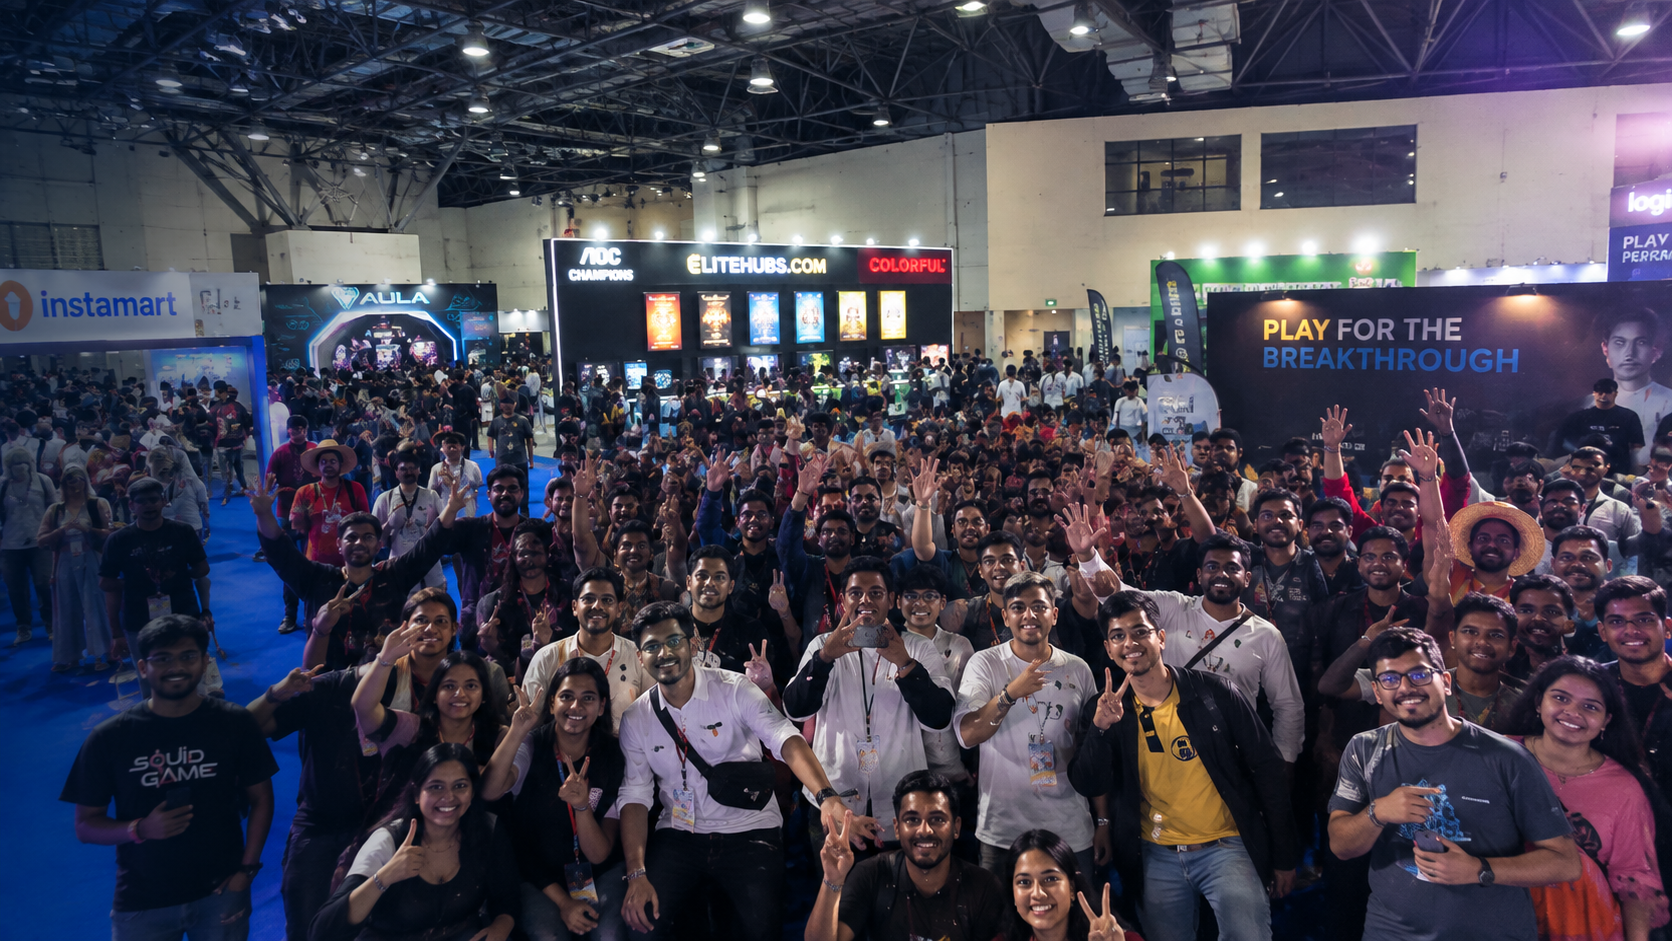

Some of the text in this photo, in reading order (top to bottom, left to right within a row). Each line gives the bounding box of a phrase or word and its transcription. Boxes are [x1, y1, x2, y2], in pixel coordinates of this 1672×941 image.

[1623, 233, 1670, 249] PLAY
[579, 247, 622, 266] AOC
[869, 257, 946, 273] COLORFUL
[568, 269, 634, 281] CHAMPIONS
[40, 290, 177, 318] instamart
[360, 291, 430, 305] AULA
[1263, 317, 1463, 341] PLAY FOR THE
[1263, 346, 1519, 373] BREAKTHROUGH
[129, 746, 205, 773] SQUID
[141, 762, 218, 788] GAME
